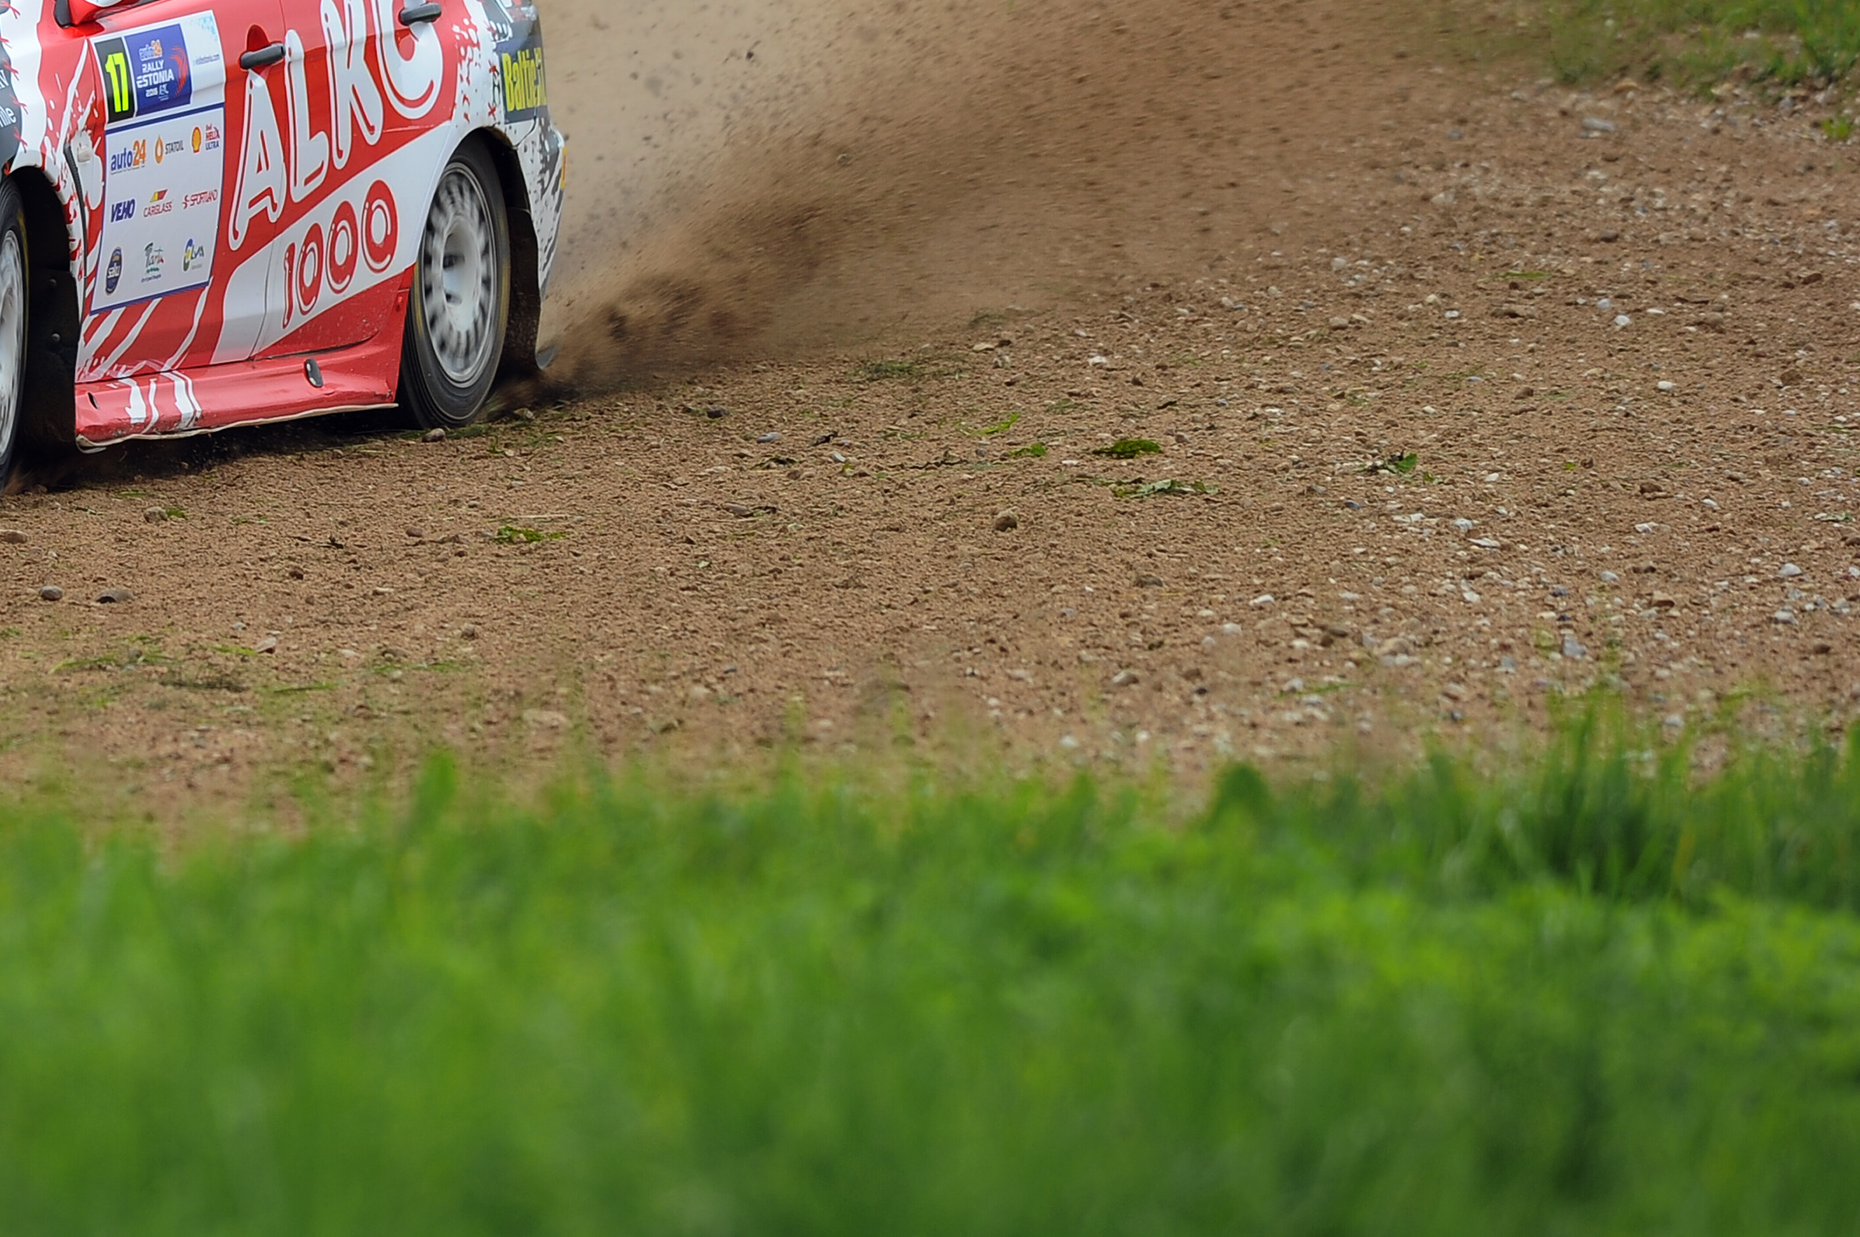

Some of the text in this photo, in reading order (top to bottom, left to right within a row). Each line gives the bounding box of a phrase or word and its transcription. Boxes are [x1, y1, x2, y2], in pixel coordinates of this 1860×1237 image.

[136, 68, 175, 89] ESTONIA
[142, 60, 165, 74] RALLY
[104, 52, 129, 113] 17
[110, 139, 146, 172] auto24
[110, 199, 136, 222] VEHO
[282, 178, 398, 329] 1000
